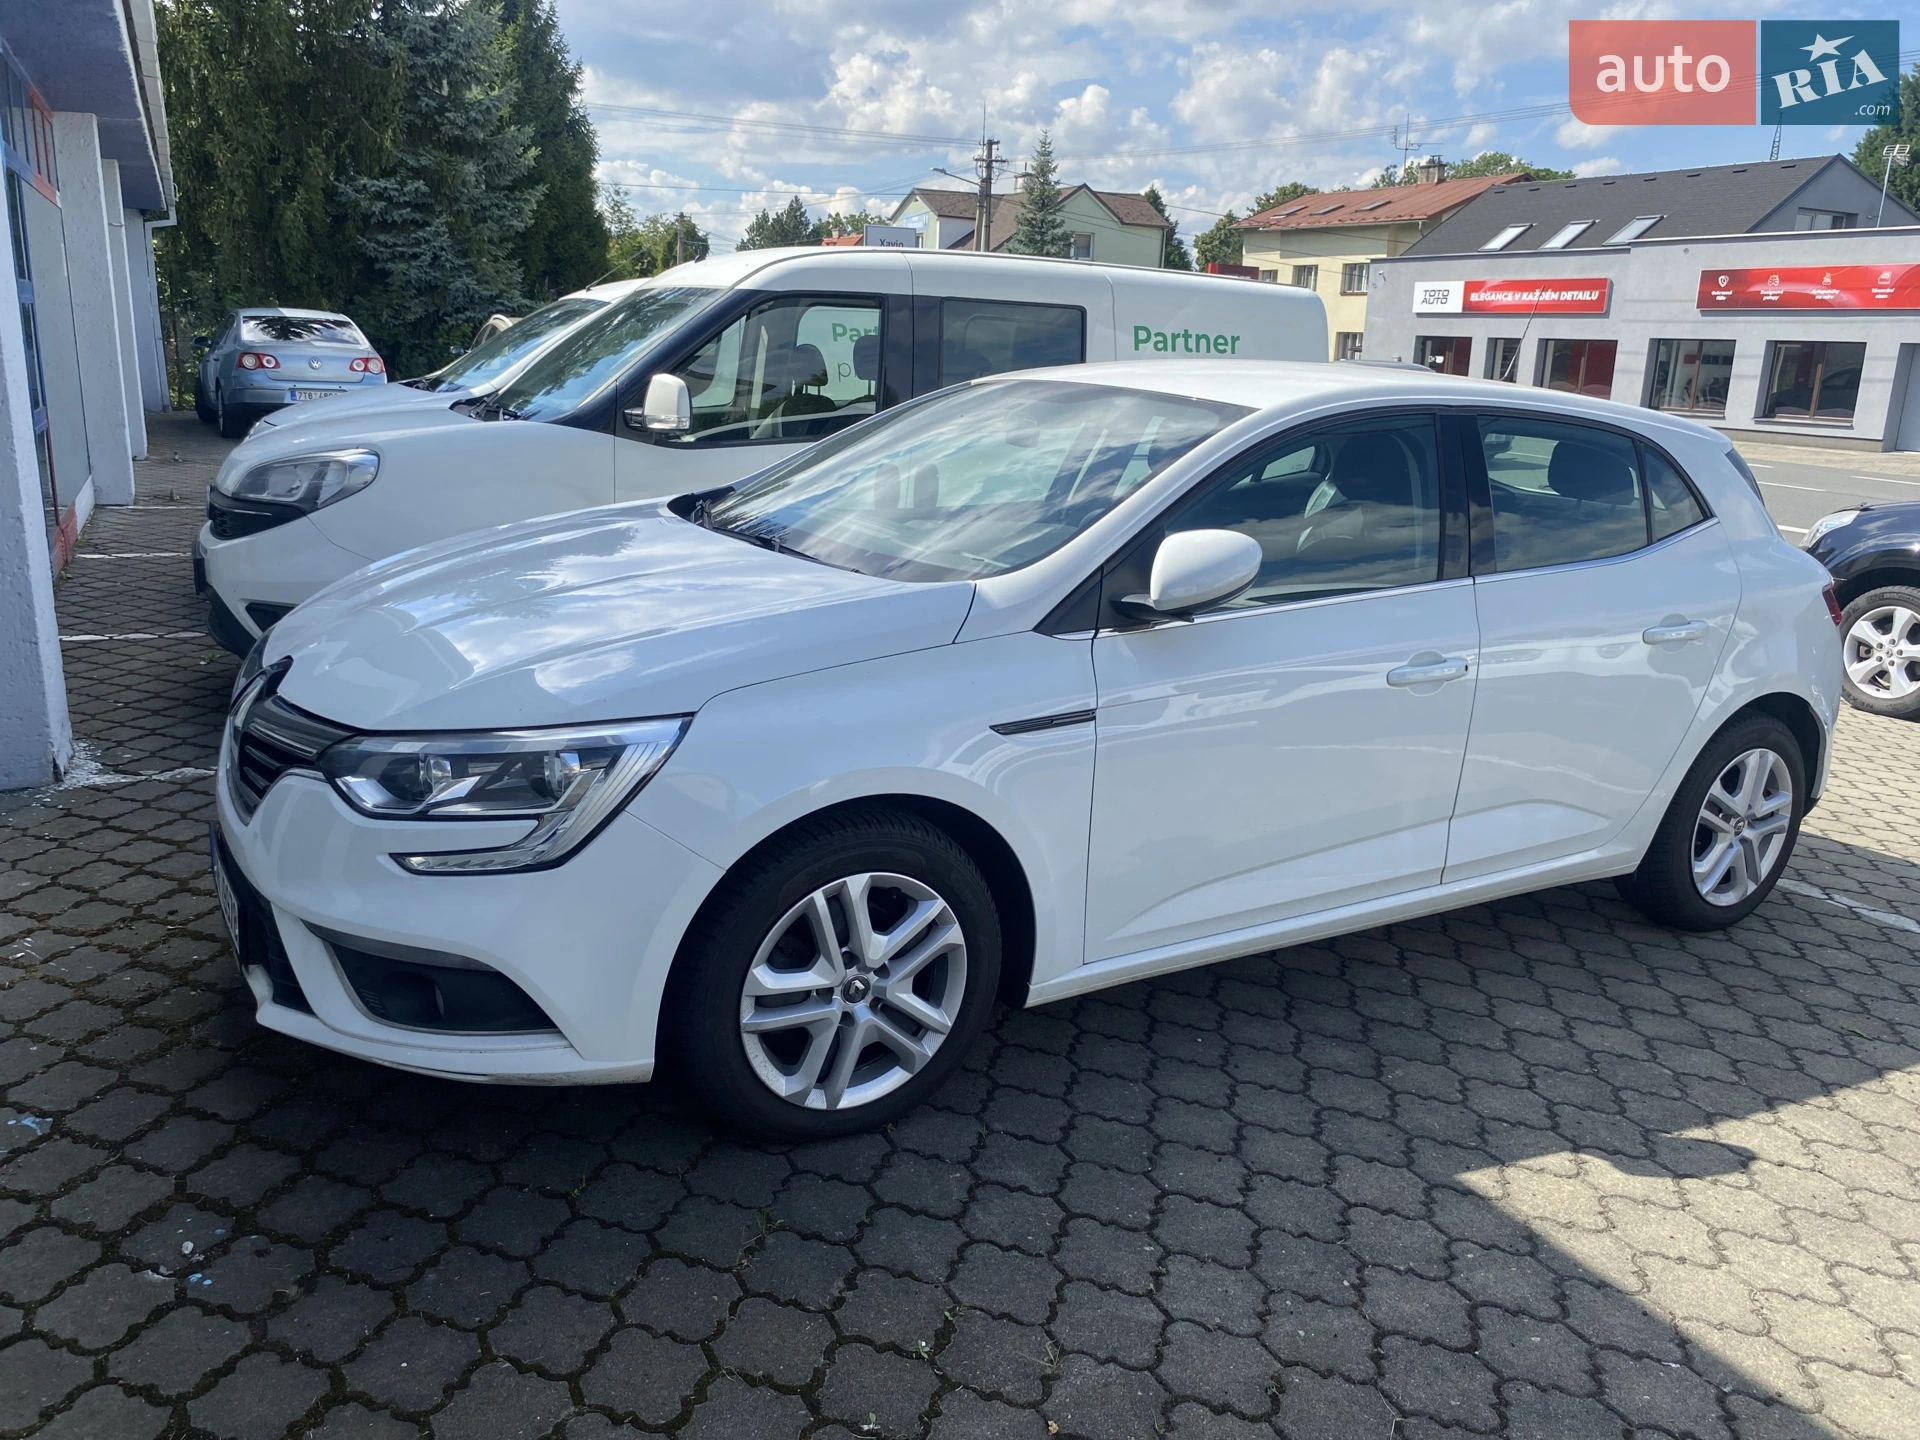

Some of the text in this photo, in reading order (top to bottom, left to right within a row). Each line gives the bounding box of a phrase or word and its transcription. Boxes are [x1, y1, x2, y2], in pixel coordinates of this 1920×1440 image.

[1423, 289, 1450, 297] TOTO
[1469, 292, 1513, 302] ELEGANCE
[1514, 291, 1522, 301] V
[1560, 290, 1600, 301] DETAILU
[1133, 325, 1241, 355] Partner
